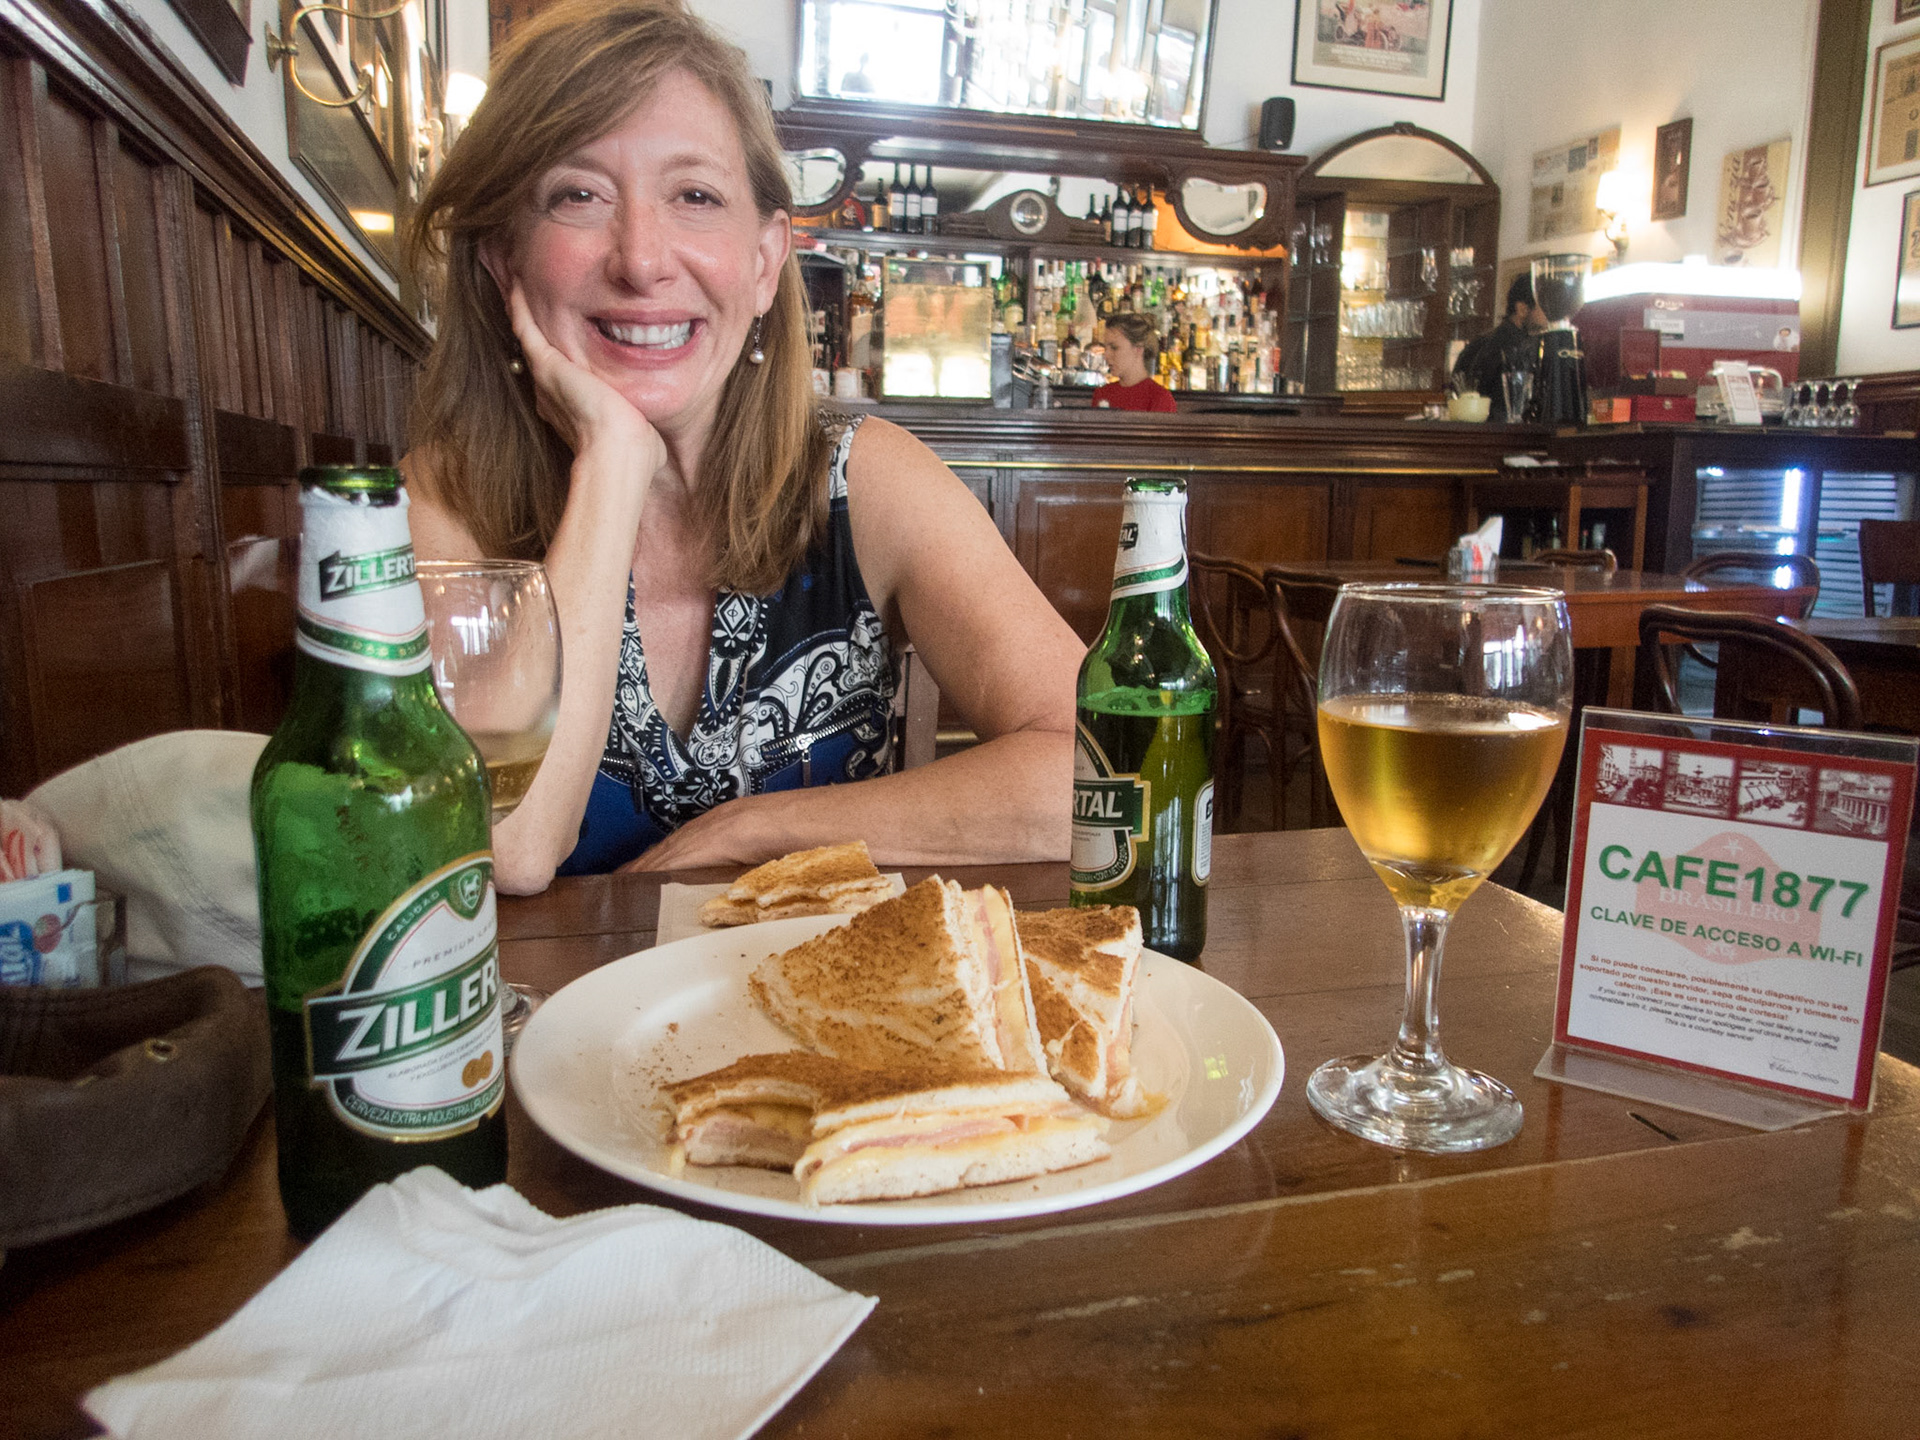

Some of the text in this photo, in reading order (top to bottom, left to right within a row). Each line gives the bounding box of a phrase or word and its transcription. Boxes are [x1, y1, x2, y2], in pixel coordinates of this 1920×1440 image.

[1598, 844, 1869, 918] CAFE1877
[387, 890, 440, 941] CALIDAD
[1591, 906, 1863, 967] CLAVE DE ACCESO A WI-FI
[413, 936, 475, 968] PREMIUM
[335, 957, 497, 1062] ZILLER
[1580, 963, 1620, 976] soportado
[1622, 972, 1636, 980] por
[1638, 975, 1669, 987] nuestro
[1712, 990, 1732, 999] sepa
[1735, 994, 1793, 1012] disculparnos
[1840, 1015, 1859, 1025] otro
[1590, 954, 1599, 962] Si
[1601, 957, 1611, 965] no
[1613, 960, 1638, 970] puede
[1691, 976, 1750, 992] posiblemente
[1751, 987, 1763, 995] su
[1764, 989, 1815, 1005] dispositivo
[1817, 1000, 1829, 1008] no
[1832, 1003, 1848, 1012] sea
[1700, 998, 1734, 1010] servicio
[1736, 1004, 1747, 1012] de
[346, 1095, 390, 1122] CERVEZA
[390, 1110, 422, 1125] EXTRA
